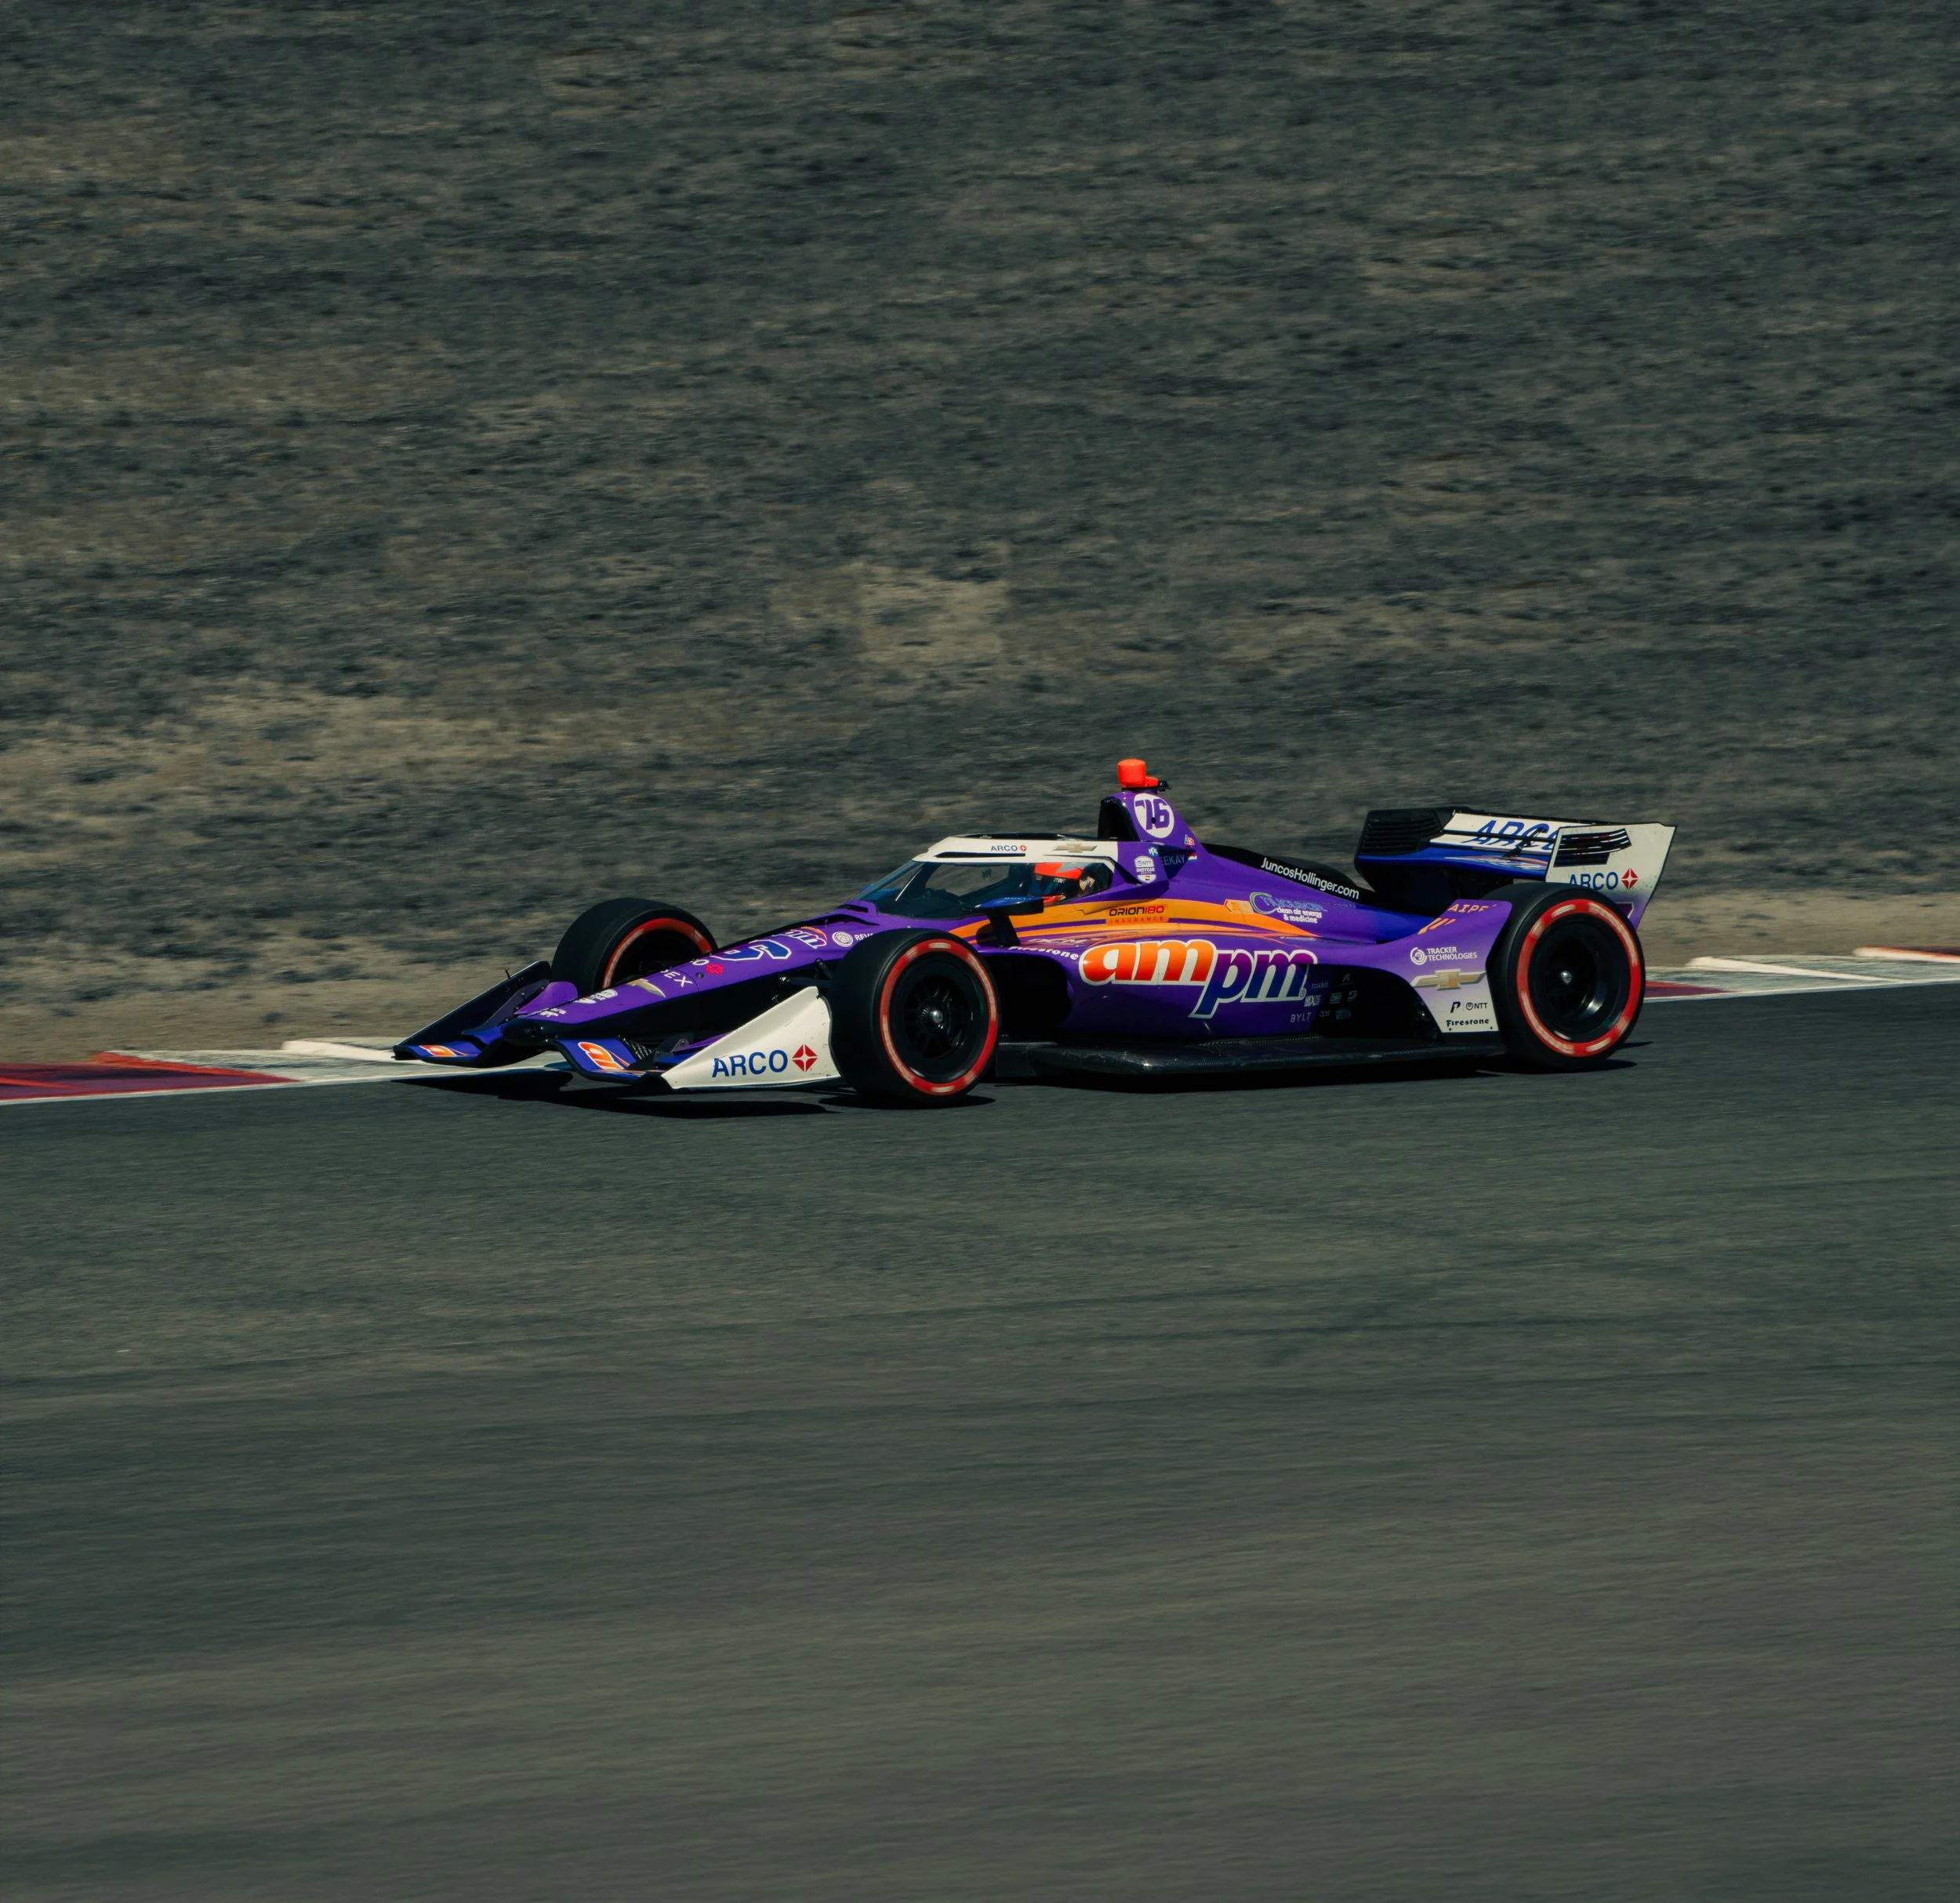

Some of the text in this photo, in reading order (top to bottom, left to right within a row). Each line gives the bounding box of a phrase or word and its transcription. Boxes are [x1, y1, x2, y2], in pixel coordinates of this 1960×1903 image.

[1135, 798, 1170, 830] 76
[1261, 858, 1359, 900] JuncosHollinger.com
[1569, 871, 1619, 891] ARCO
[1109, 905, 1165, 917] ORION180
[1301, 910, 1323, 919] energy
[1290, 915, 1318, 924] medicine
[1427, 946, 1457, 955] TRACKER
[1427, 952, 1478, 961] TECHNOLOGIES
[1079, 939, 1319, 1019] ampm
[1290, 1012, 1312, 1022] BYLT
[1446, 1019, 1490, 1028] Firestone
[712, 1049, 789, 1078] ARCO
